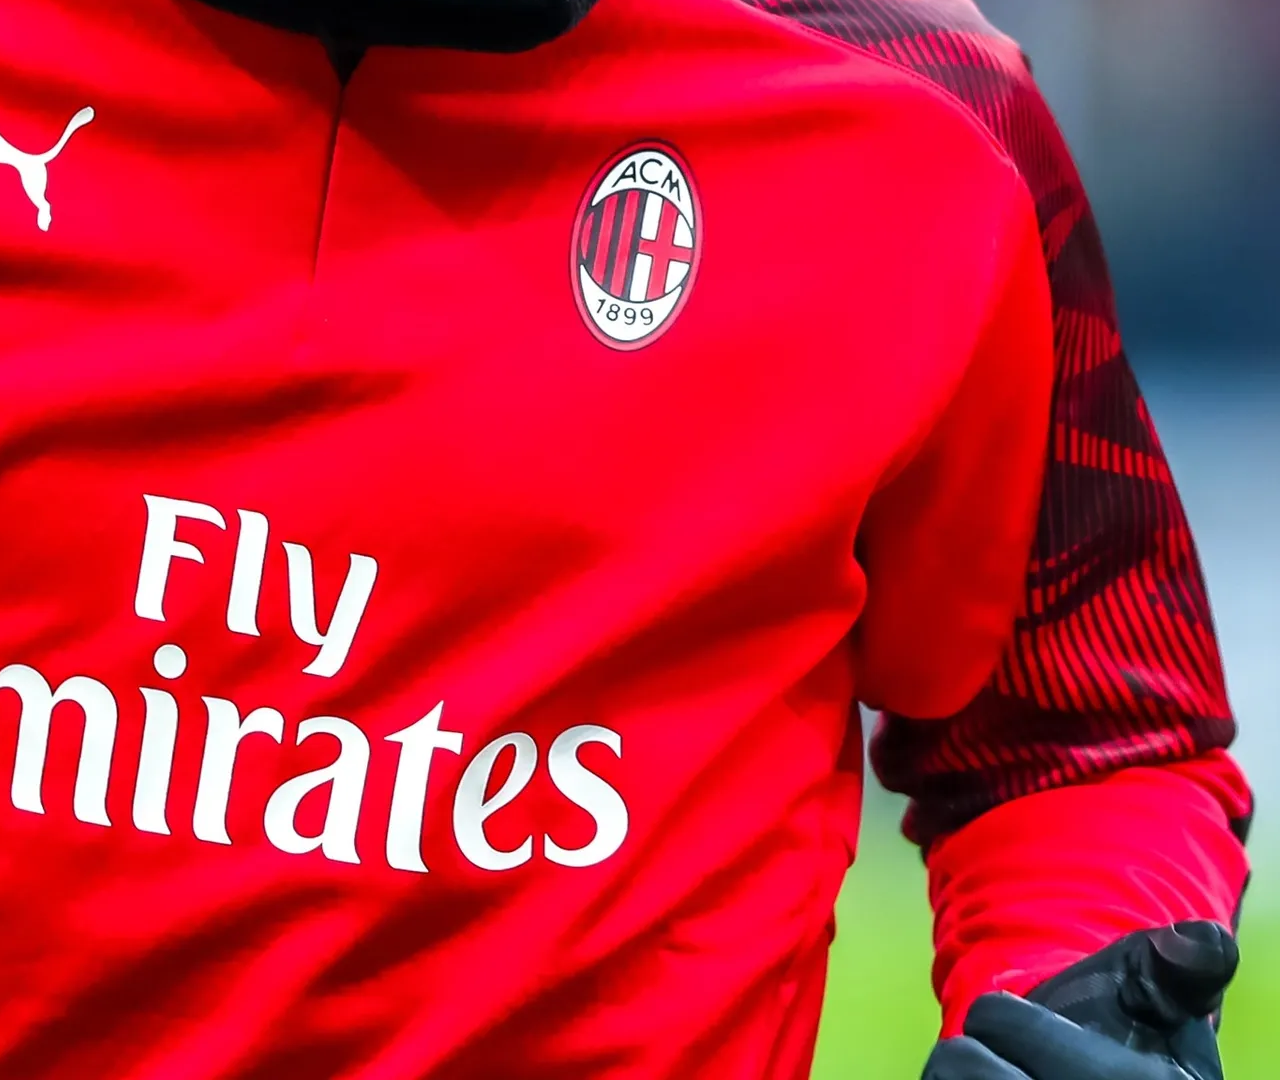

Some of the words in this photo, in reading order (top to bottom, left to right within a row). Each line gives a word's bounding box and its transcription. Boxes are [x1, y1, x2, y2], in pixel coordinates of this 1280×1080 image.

[611, 158, 681, 202] ACM
[596, 298, 654, 326] 1899
[133, 493, 379, 678] Fly
